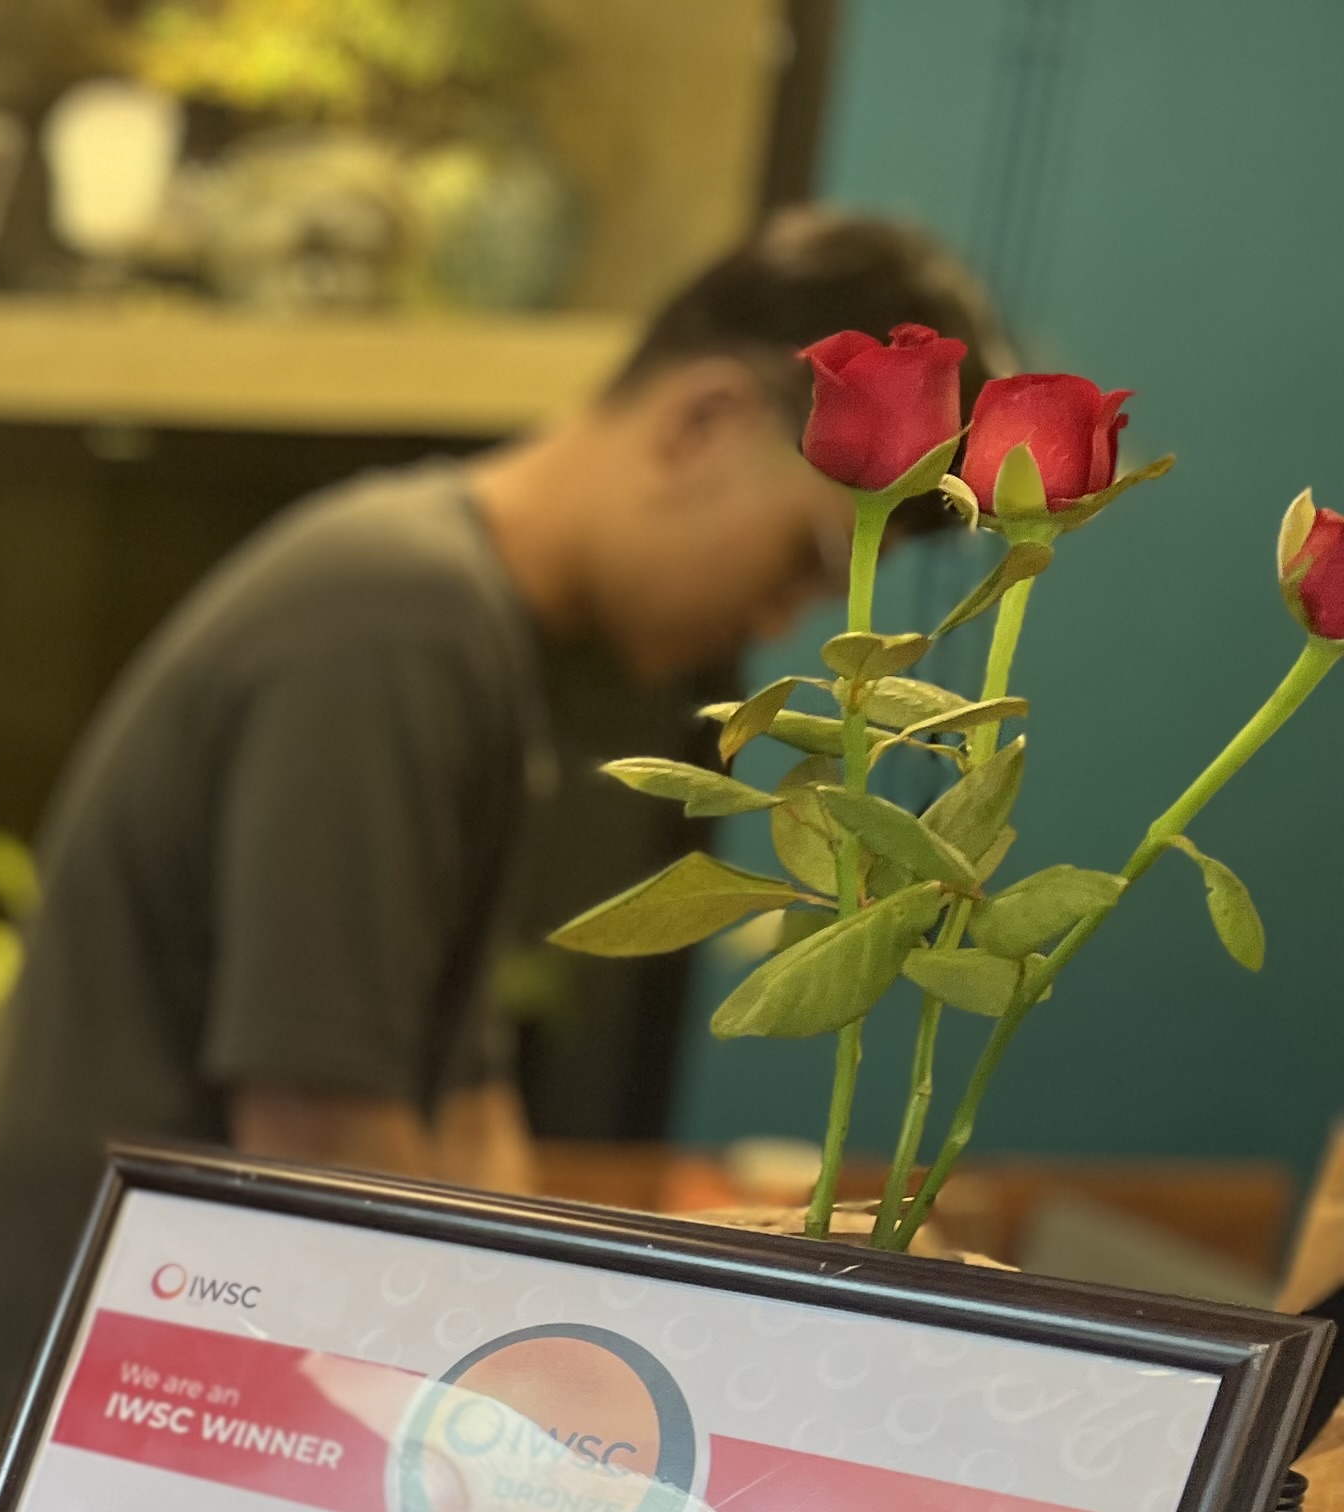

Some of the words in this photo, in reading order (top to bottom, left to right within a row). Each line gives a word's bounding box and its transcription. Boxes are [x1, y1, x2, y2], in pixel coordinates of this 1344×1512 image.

[188, 1274, 262, 1309] IWSC
[119, 1361, 159, 1390] We
[163, 1374, 201, 1398] are
[205, 1382, 240, 1406] an
[104, 1391, 194, 1435] IWSC
[199, 1415, 344, 1471] WINNER
[509, 1420, 638, 1479] IWSC
